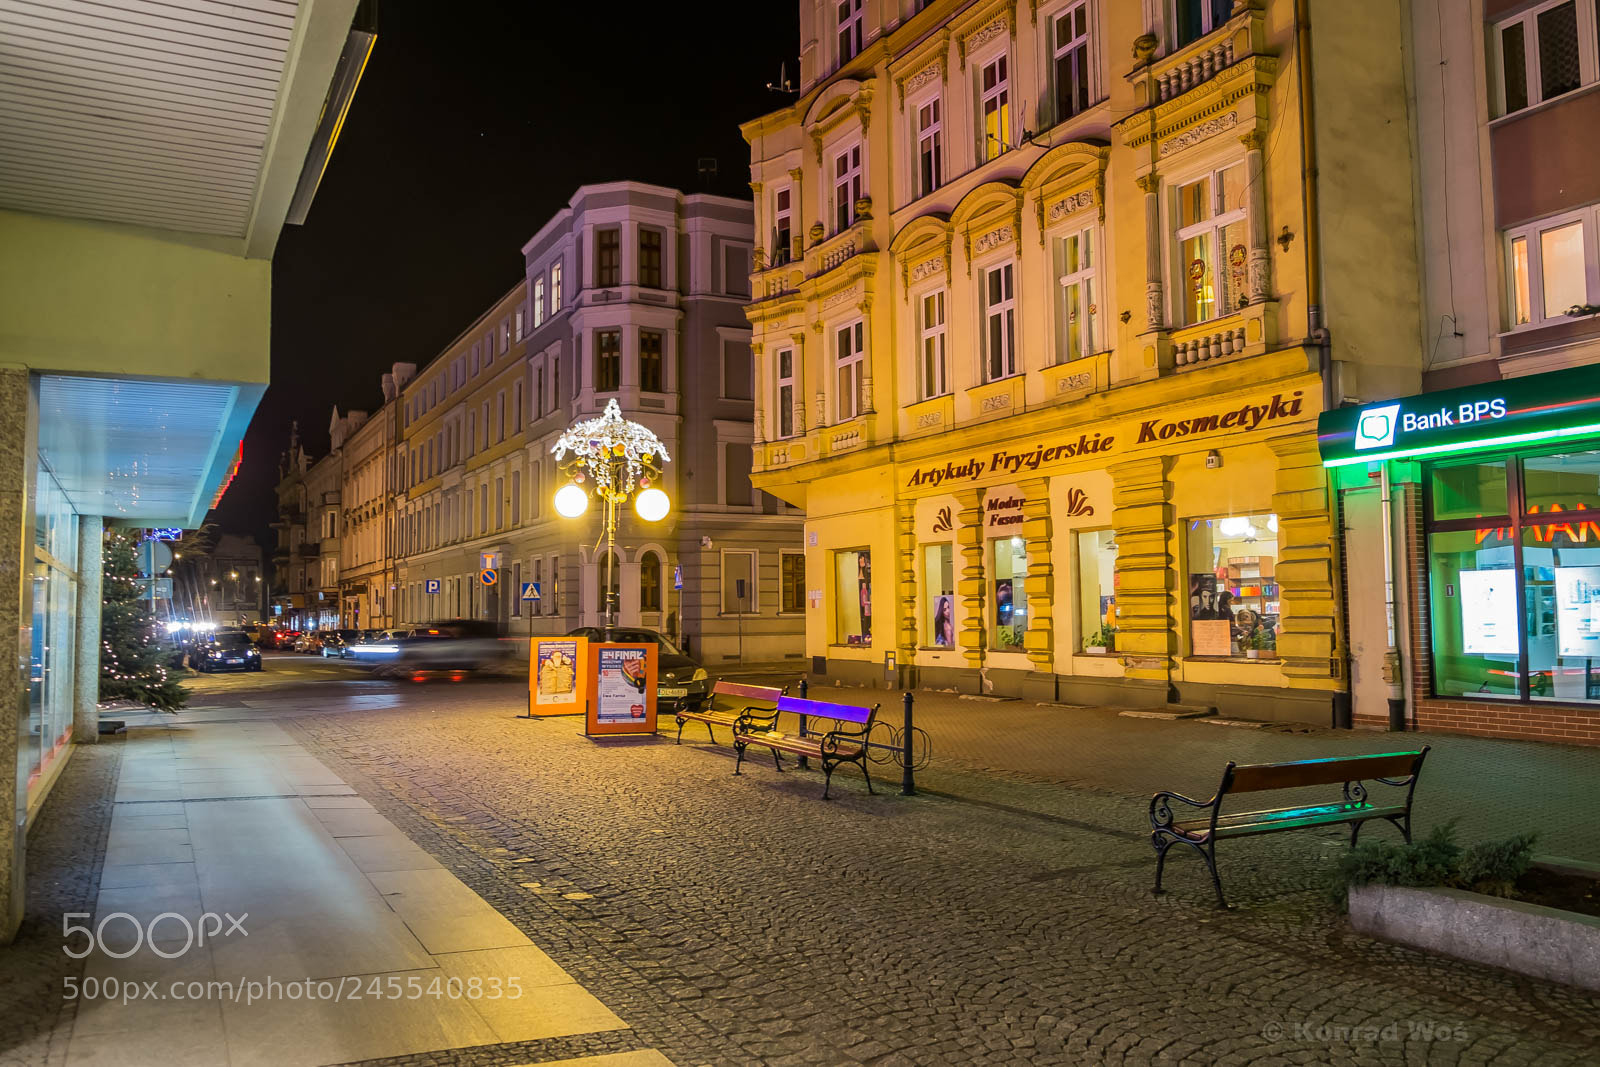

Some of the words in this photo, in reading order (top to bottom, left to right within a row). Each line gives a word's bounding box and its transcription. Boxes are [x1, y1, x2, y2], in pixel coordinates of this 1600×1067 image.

[1403, 407, 1454, 432] Bank
[1459, 398, 1507, 423] BPS
[906, 458, 985, 487] Artykuły
[989, 432, 1115, 474] Fryzjerskie
[1136, 390, 1304, 445] Kosmetyki
[987, 496, 1026, 511] Modny
[990, 513, 1024, 526] Fason
[428, 581, 437, 592] P
[602, 651, 614, 659] 24
